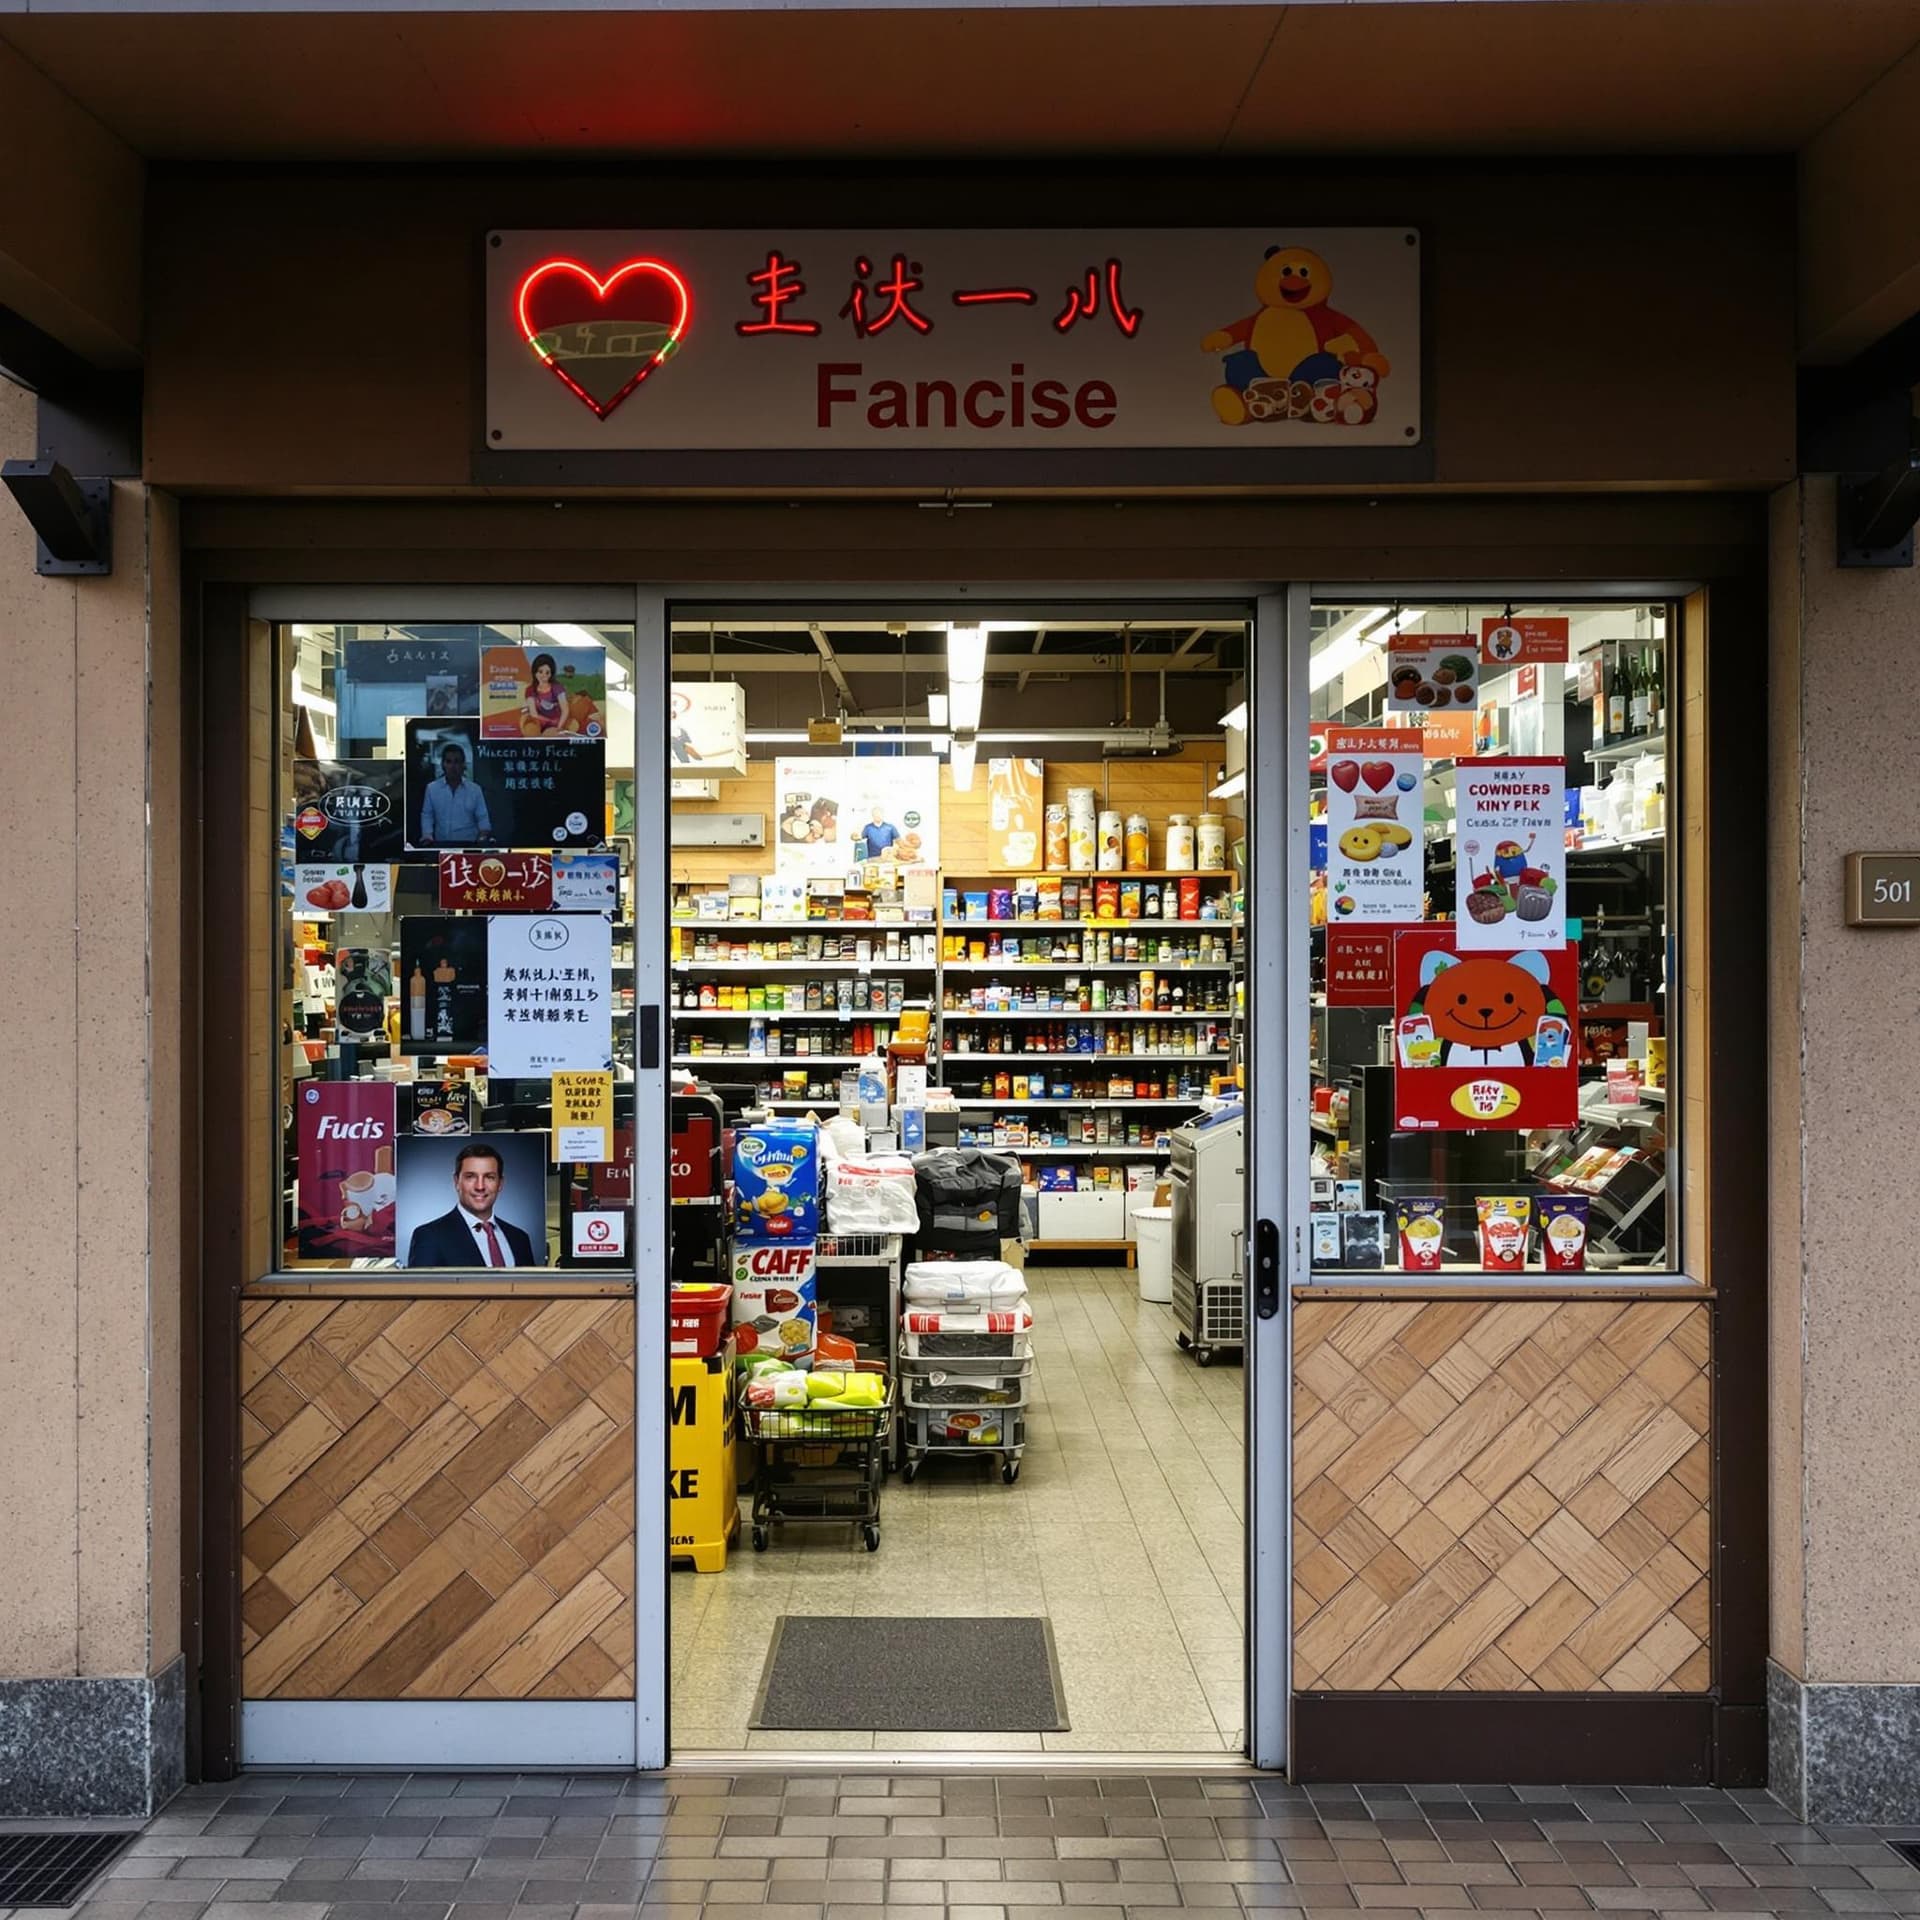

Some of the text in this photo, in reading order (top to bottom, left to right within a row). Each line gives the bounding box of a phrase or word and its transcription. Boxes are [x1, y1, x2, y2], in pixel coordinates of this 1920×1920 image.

[817, 362, 1118, 429] Fancise
[1468, 784, 1551, 796] COWNDERS
[1476, 800, 1511, 812] KINY
[1873, 878, 1911, 903] 501
[317, 1115, 385, 1140] Fucis
[751, 1248, 814, 1276] CAFF
